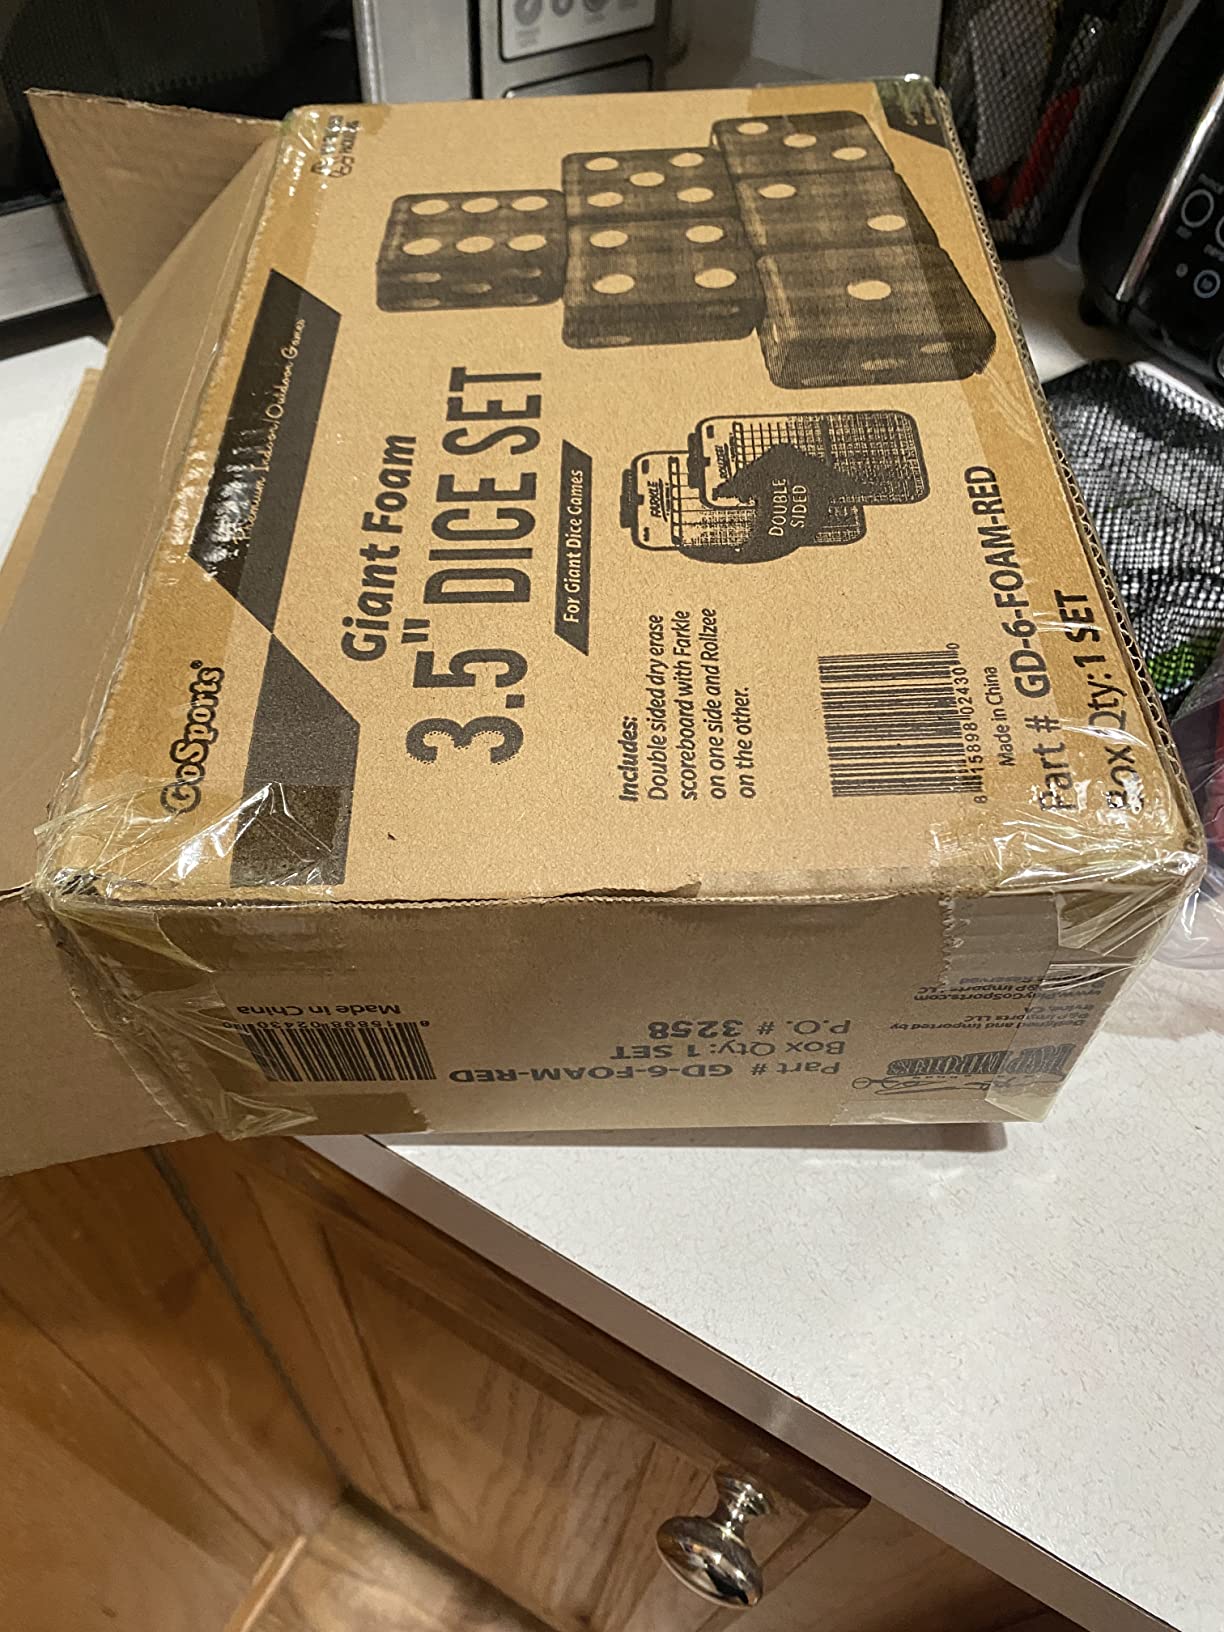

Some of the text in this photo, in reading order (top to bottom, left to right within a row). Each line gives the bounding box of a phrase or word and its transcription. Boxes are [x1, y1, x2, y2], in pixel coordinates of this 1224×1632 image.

[280, 318, 307, 360] Games
[647, 480, 662, 518] FARKLE
[767, 478, 788, 537] DOUBLE
[789, 484, 808, 528] SIDED
[340, 434, 416, 662] Giant Foam
[400, 365, 543, 766] 3.5" DICE SET
[562, 469, 585, 624] For Giant Dice Games
[964, 466, 1076, 812] Part # GD-6-FOAM-RED
[1054, 589, 1101, 643] SET
[1073, 654, 1107, 668] 1
[646, 614, 670, 801] Double sided dry erase
[671, 610, 697, 800] scoreboard with Farkle
[699, 608, 727, 800] on one side and Rollzee
[952, 667, 975, 715] 02430
[982, 666, 1016, 767] Made in China
[1083, 672, 1128, 731] Qty:
[618, 715, 640, 802] Includes:
[731, 686, 756, 799] on the other.
[236, 1004, 400, 1016] Made in China
[647, 1020, 851, 1039] P.O. # 3258
[449, 1061, 840, 1083] Part # GD-6-FOAM-RED
[610, 1040, 845, 1059] Box Qty: 1 SET
